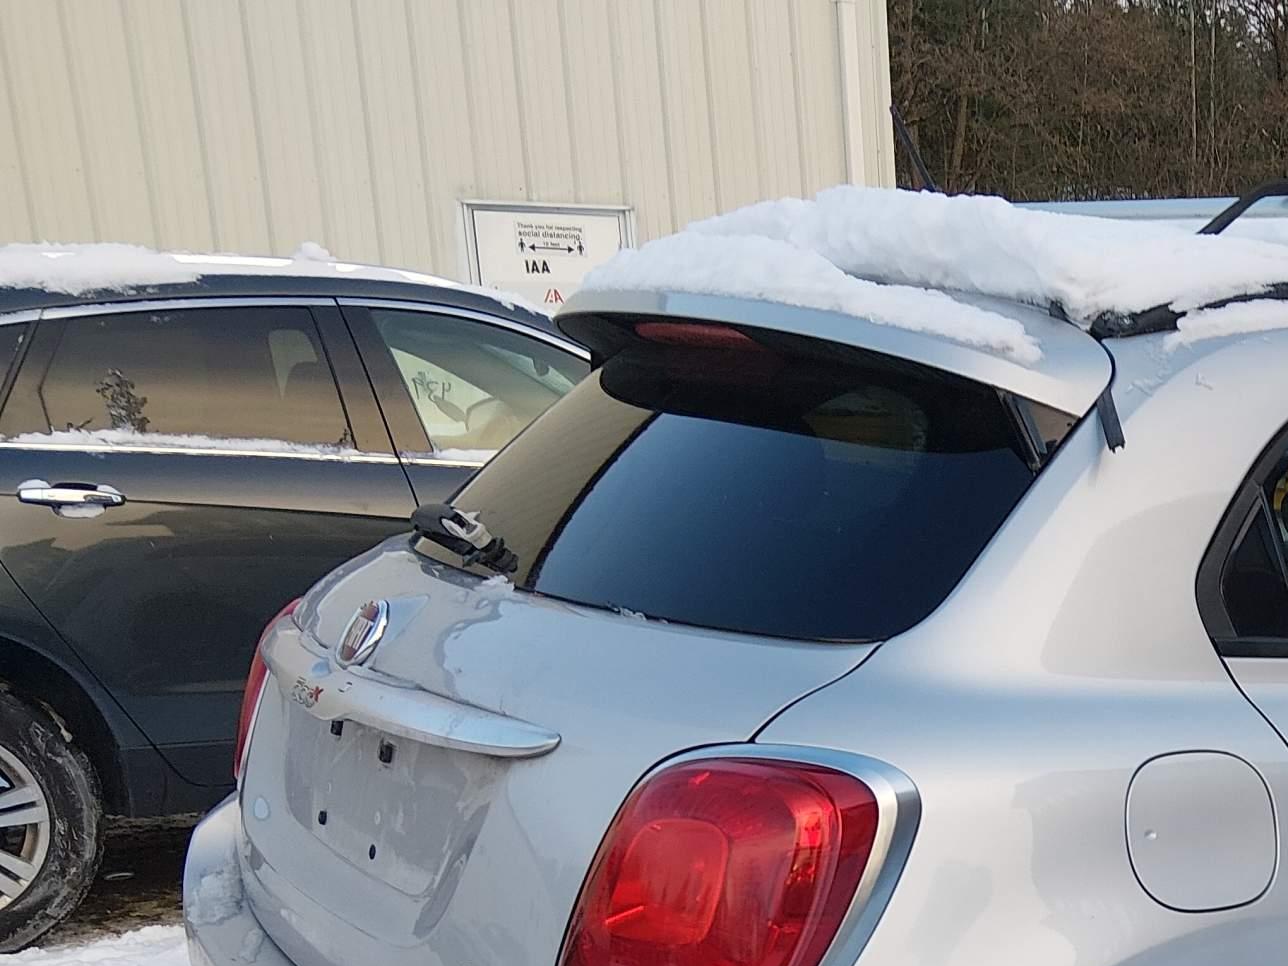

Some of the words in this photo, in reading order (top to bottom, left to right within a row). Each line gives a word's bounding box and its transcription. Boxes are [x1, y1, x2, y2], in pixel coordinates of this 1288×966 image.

[518, 230, 540, 238] social
[542, 232, 583, 241] distancing.
[525, 259, 551, 274] IAA
